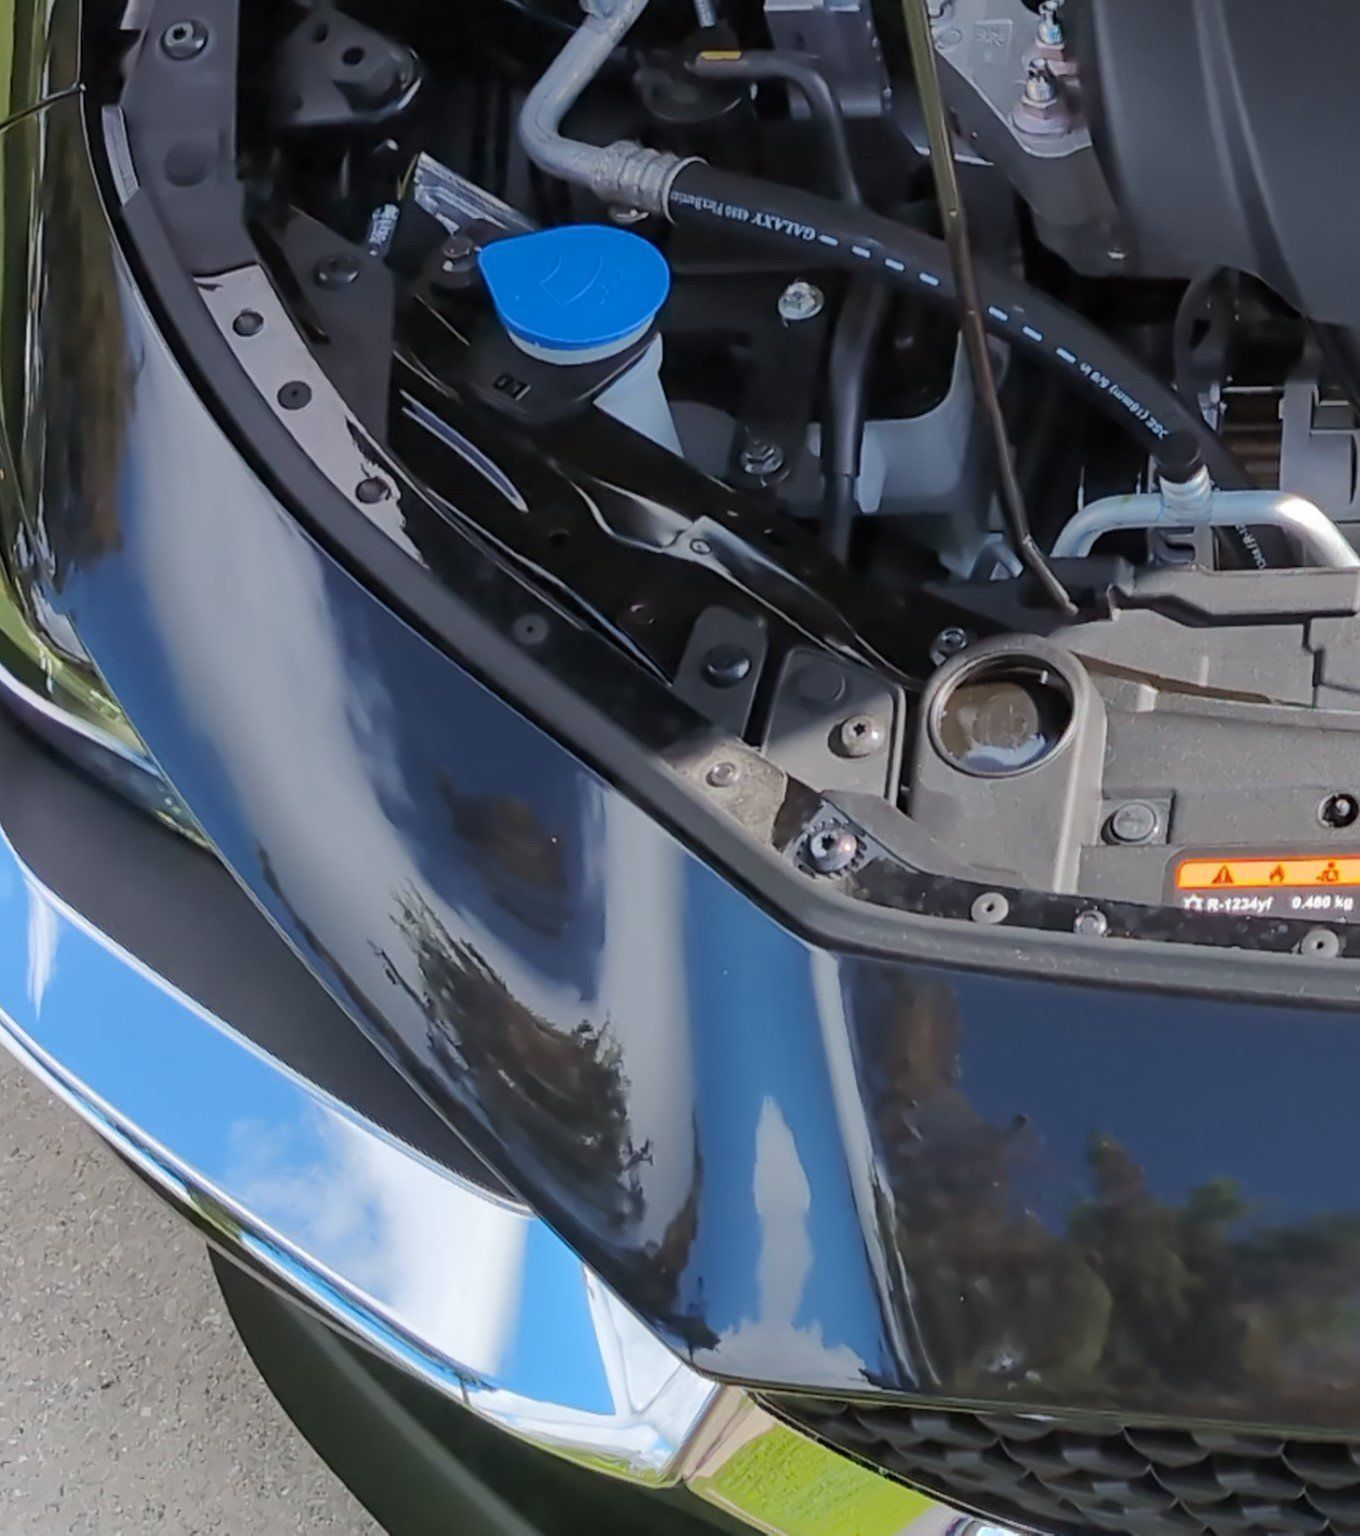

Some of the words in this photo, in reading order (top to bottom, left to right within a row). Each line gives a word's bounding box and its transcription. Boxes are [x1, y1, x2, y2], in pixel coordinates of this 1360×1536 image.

[752, 212, 816, 241] GALAXY
[1206, 895, 1273, 913] R-1234yf
[1334, 894, 1354, 911] kg
